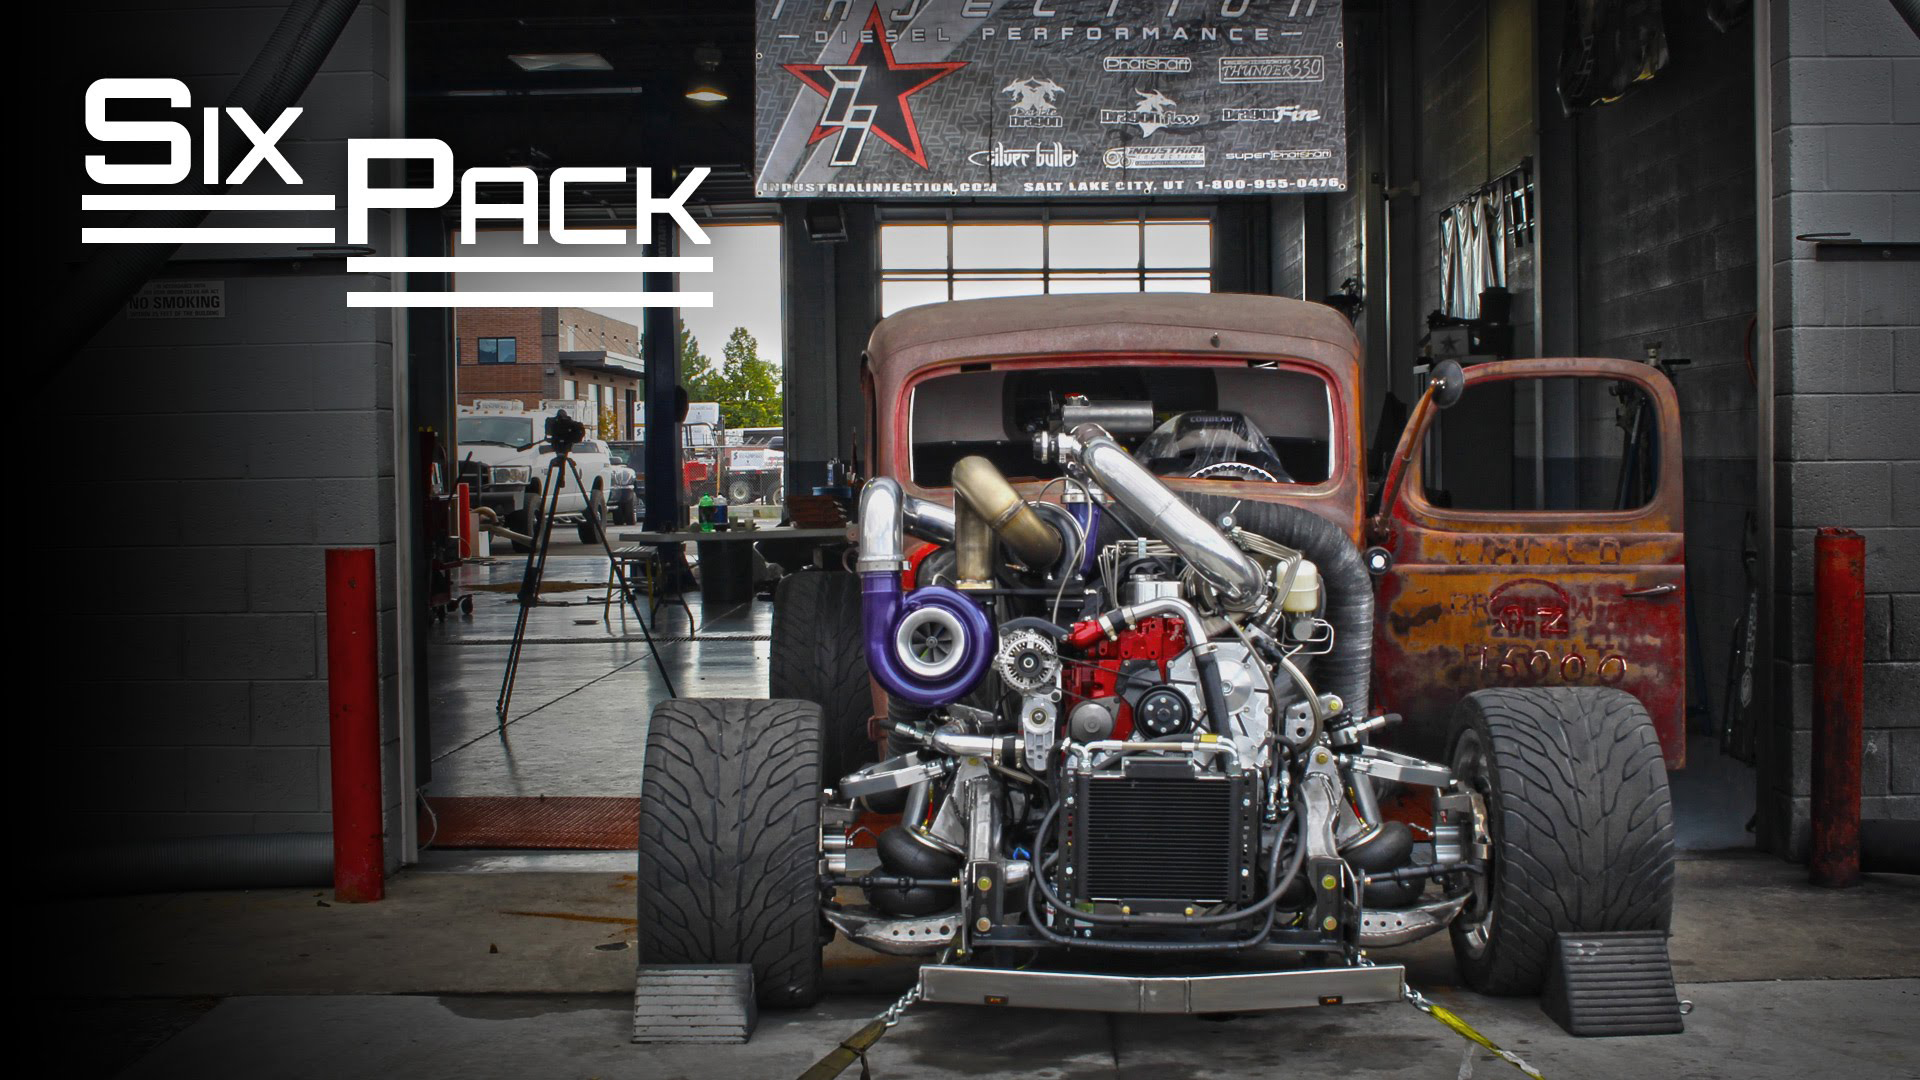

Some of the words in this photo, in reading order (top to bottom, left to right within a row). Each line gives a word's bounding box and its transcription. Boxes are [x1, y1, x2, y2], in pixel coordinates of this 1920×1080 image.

[814, 28, 950, 44] DIESEL
[981, 27, 1269, 41] PERFORMANCE
[1036, 141, 1079, 167] bullet
[1023, 181, 1063, 192] SALT
[1069, 181, 1109, 191] LAKE
[1163, 180, 1184, 190] UT
[1195, 178, 1337, 189] 1-800-955-0476
[129, 296, 149, 309] NO
[153, 295, 220, 309] SMOKING
